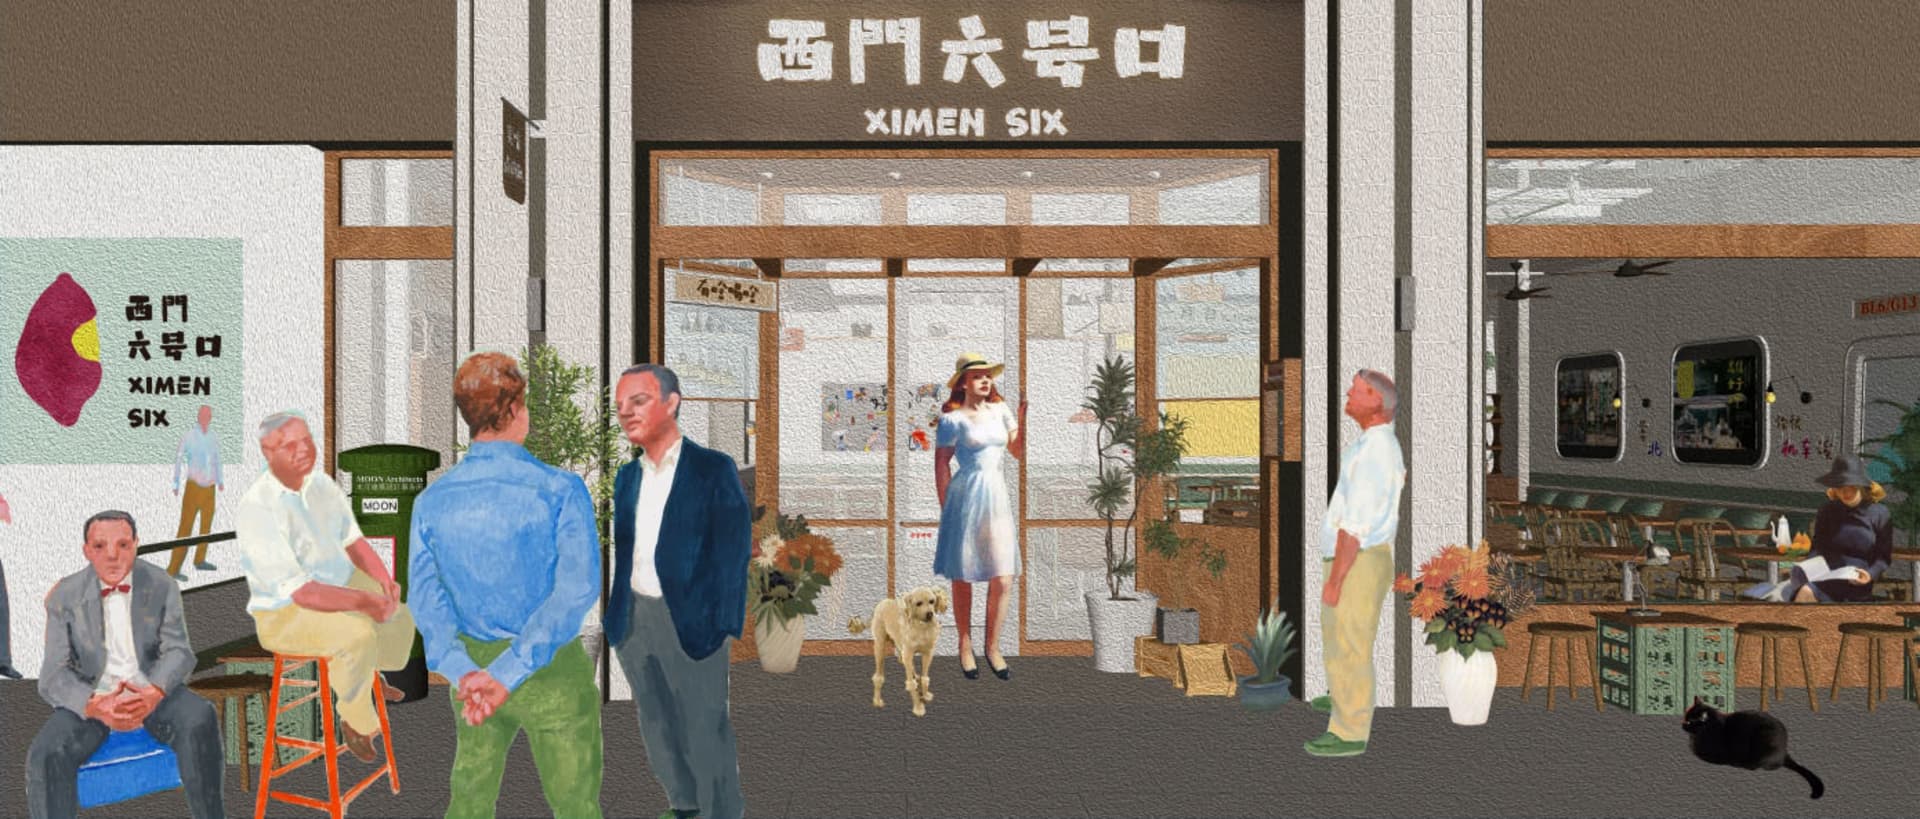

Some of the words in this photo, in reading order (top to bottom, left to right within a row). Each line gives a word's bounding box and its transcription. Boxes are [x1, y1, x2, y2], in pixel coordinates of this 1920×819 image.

[864, 108, 985, 137] XIMEN
[1005, 107, 1068, 138] SIX
[125, 295, 188, 322] 西門
[128, 376, 211, 396] XIMEN
[127, 408, 169, 428] SIX
[356, 475, 384, 483] MOON
[386, 474, 424, 483] Architects
[363, 501, 398, 511] MOON
